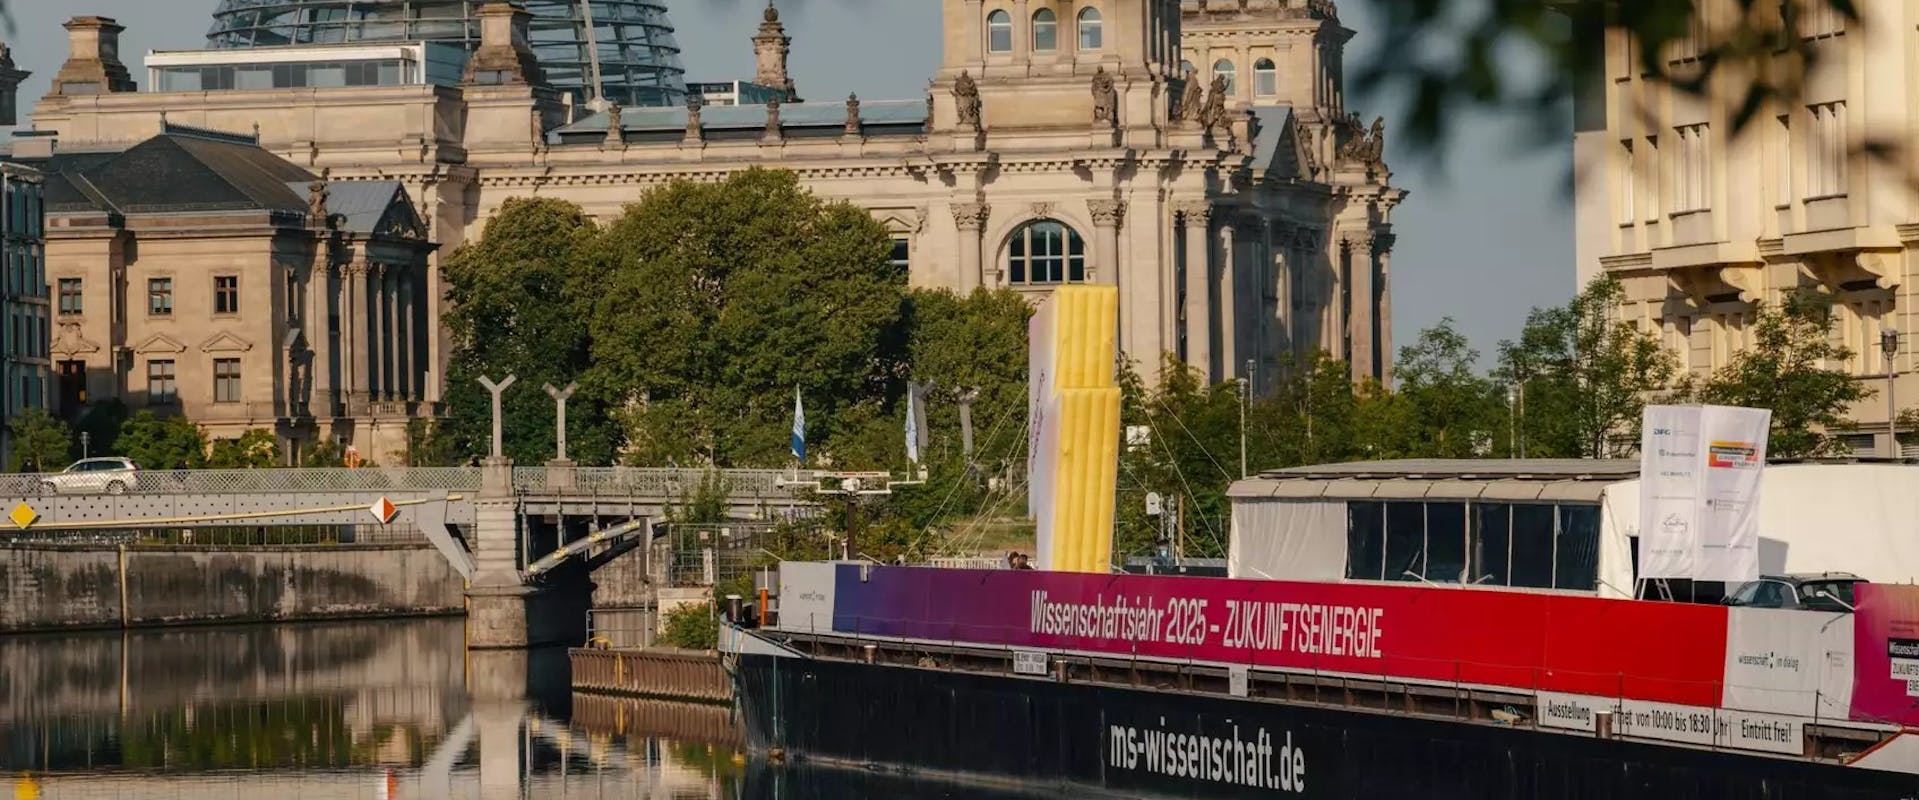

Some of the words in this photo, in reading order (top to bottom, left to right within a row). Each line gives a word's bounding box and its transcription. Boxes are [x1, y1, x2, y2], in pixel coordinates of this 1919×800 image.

[1030, 590, 1164, 650] Wissenschaftsjahr
[1166, 597, 1209, 645] 2025
[1223, 600, 1384, 658] ZUKUNFTSENERGIE
[1889, 641, 1919, 655] Wissenscha
[1548, 699, 1591, 726] Ausstellung
[1636, 712, 1650, 727] von
[1652, 710, 1673, 730] 10:00
[1675, 712, 1687, 732] bis
[1689, 713, 1710, 734] 18:30
[1714, 716, 1728, 737] Uhr
[1741, 719, 1772, 741] Eintritt
[1773, 720, 1792, 743] frei!
[1110, 716, 1306, 793] ms-wissenschaft.de
